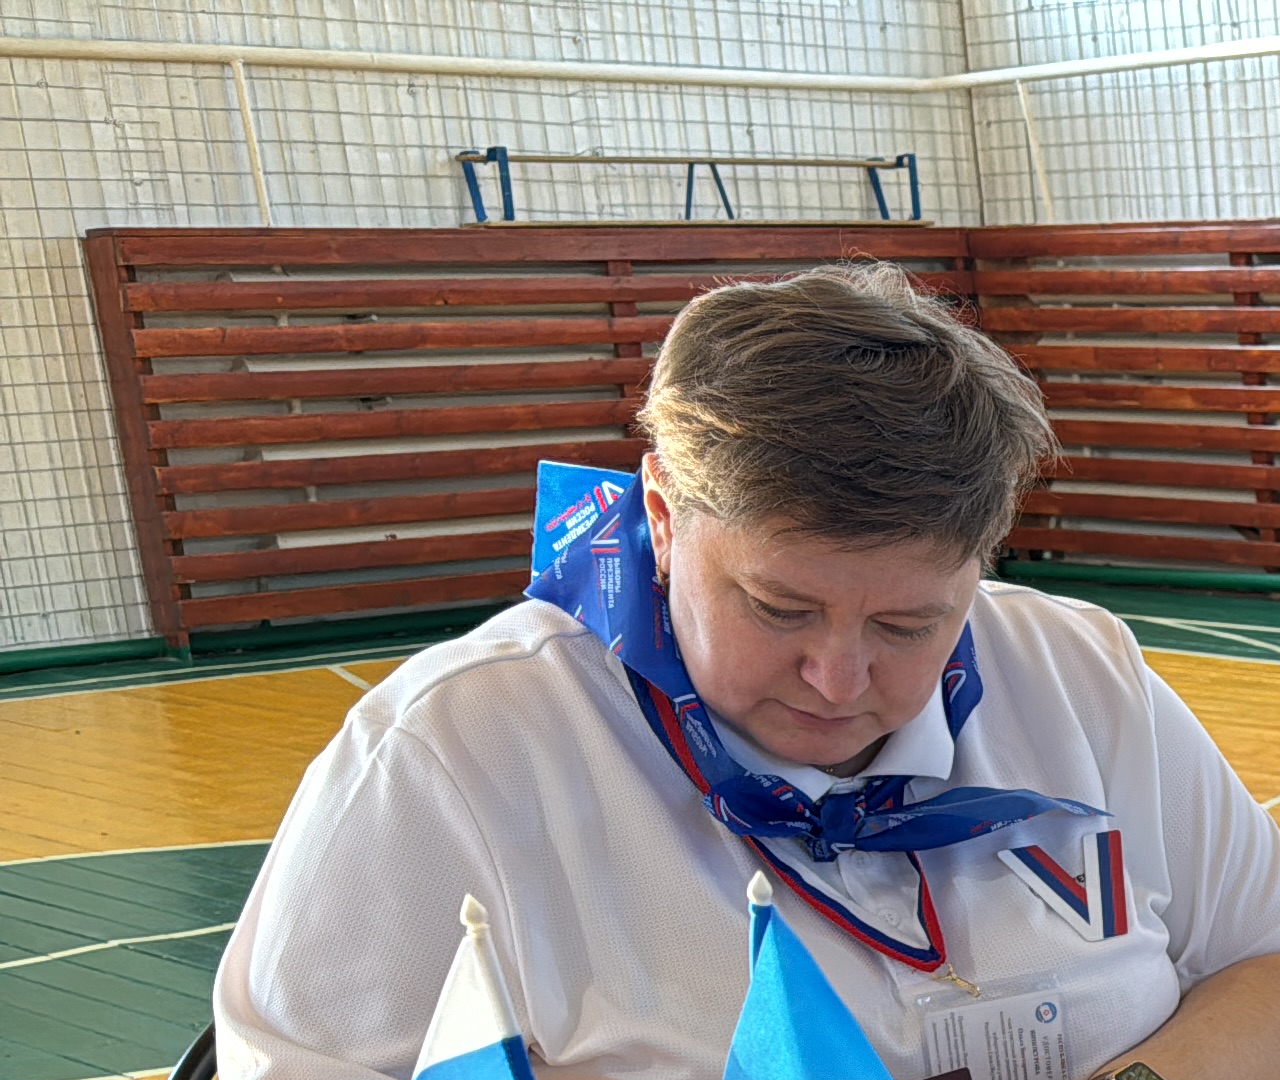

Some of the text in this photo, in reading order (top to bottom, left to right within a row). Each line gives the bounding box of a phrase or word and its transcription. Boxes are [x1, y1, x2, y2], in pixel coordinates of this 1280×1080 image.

[597, 556, 607, 591] РОССИИ
[605, 556, 615, 609] ПРЕЗИДЕНТА
[613, 556, 621, 594] ВЫБОРЫ
